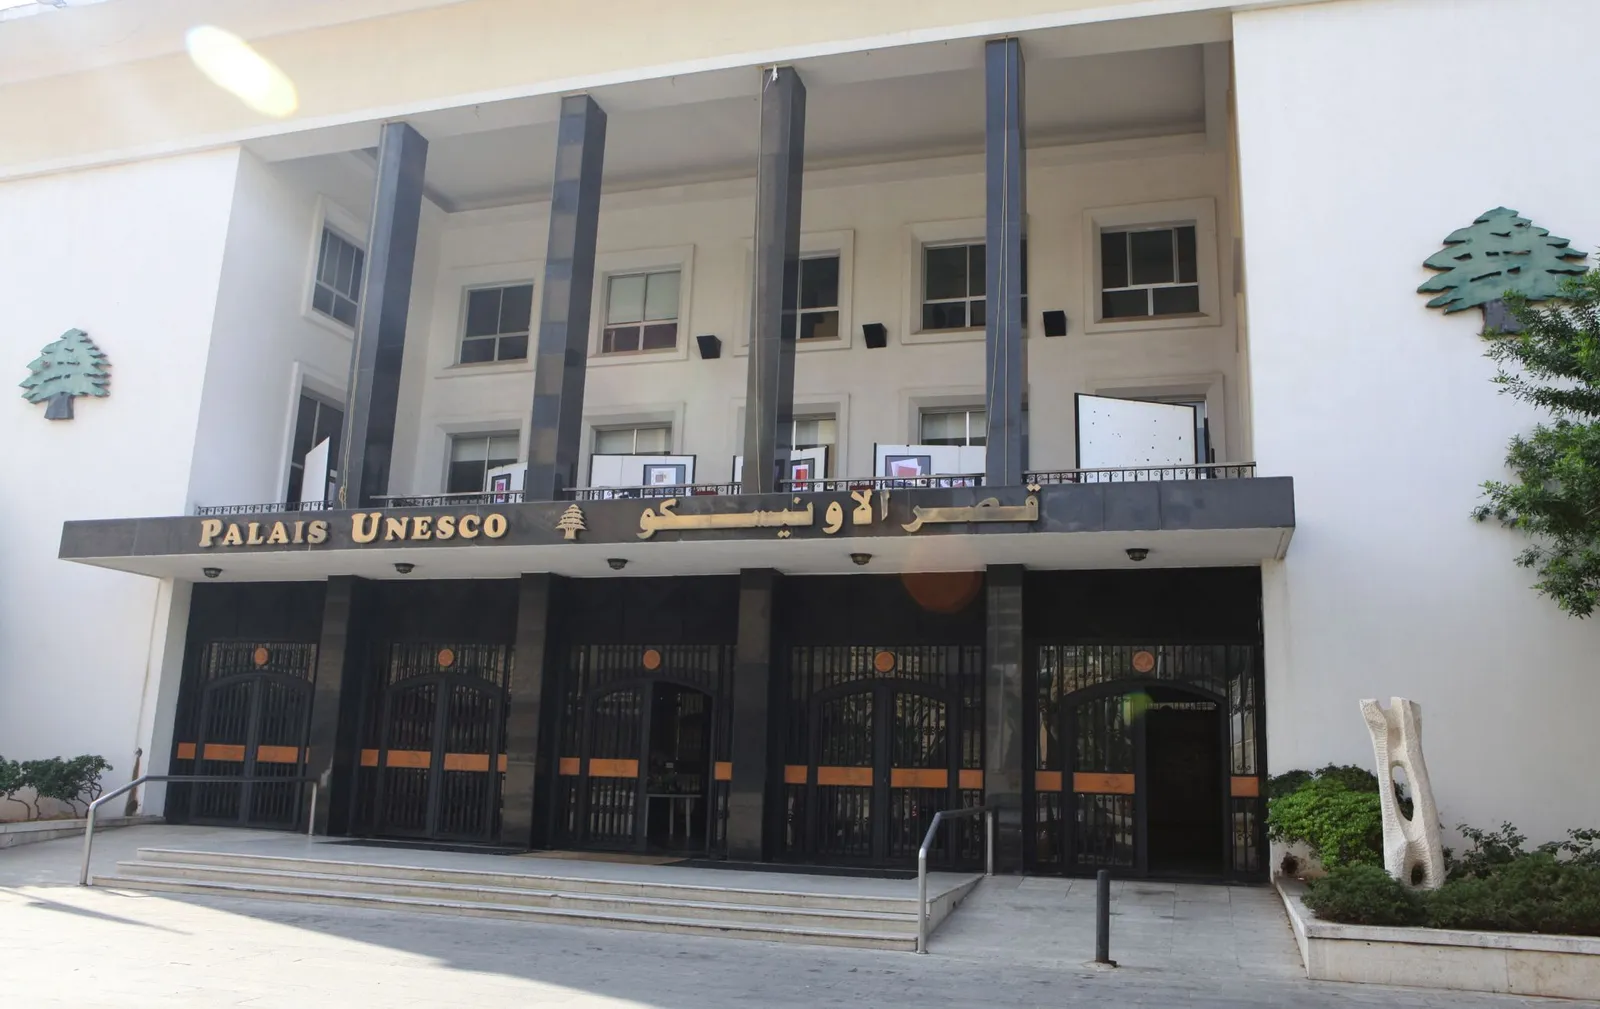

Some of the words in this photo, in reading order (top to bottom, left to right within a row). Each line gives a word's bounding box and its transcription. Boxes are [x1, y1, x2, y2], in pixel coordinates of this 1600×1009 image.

[199, 518, 329, 547] PALAIS
[351, 512, 508, 543] UNESCO
[900, 484, 1039, 533] قصر
